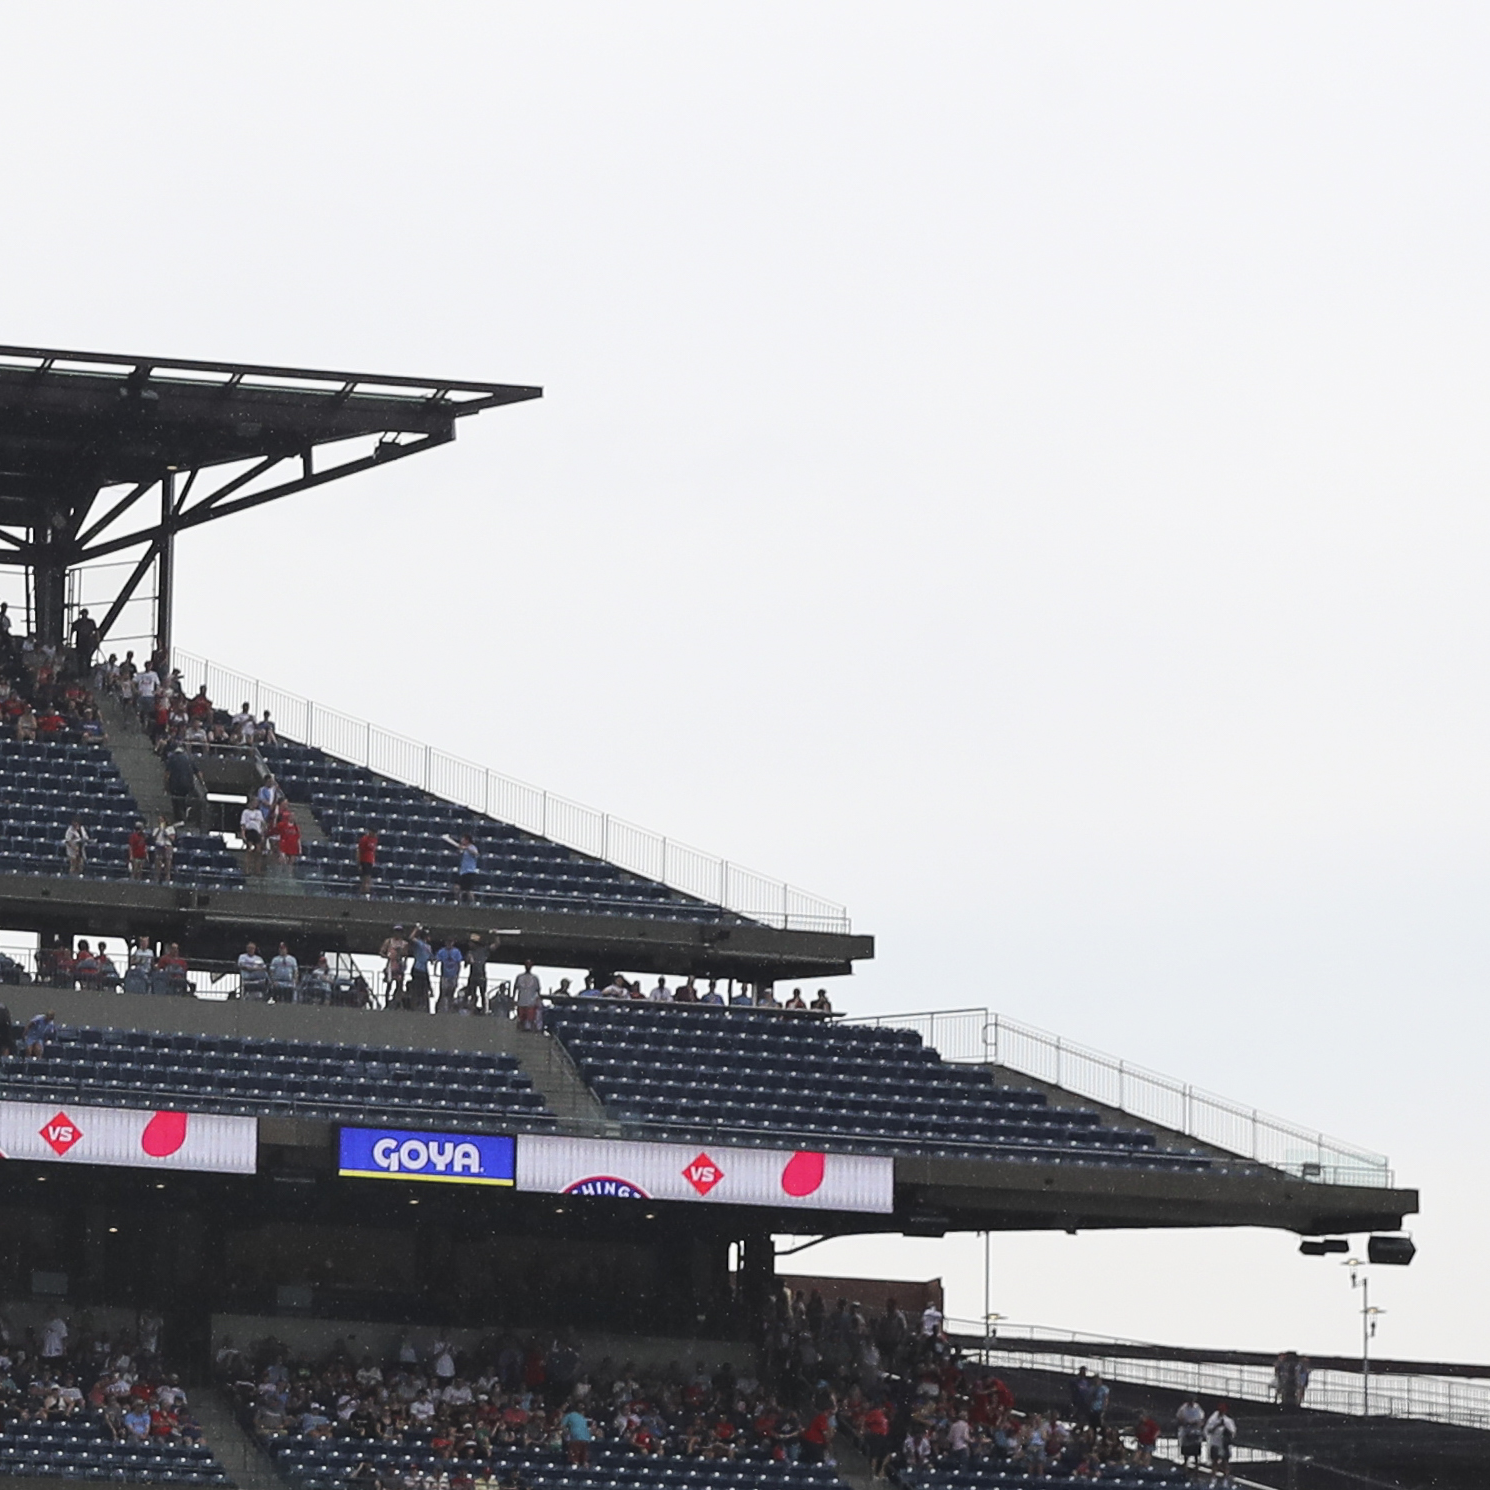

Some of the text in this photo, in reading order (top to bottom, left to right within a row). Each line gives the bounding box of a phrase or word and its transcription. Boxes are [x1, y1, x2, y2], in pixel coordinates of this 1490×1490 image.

[48, 1126, 73, 1142] VS
[373, 1138, 481, 1174] GOYA
[690, 1166, 716, 1182] VS
